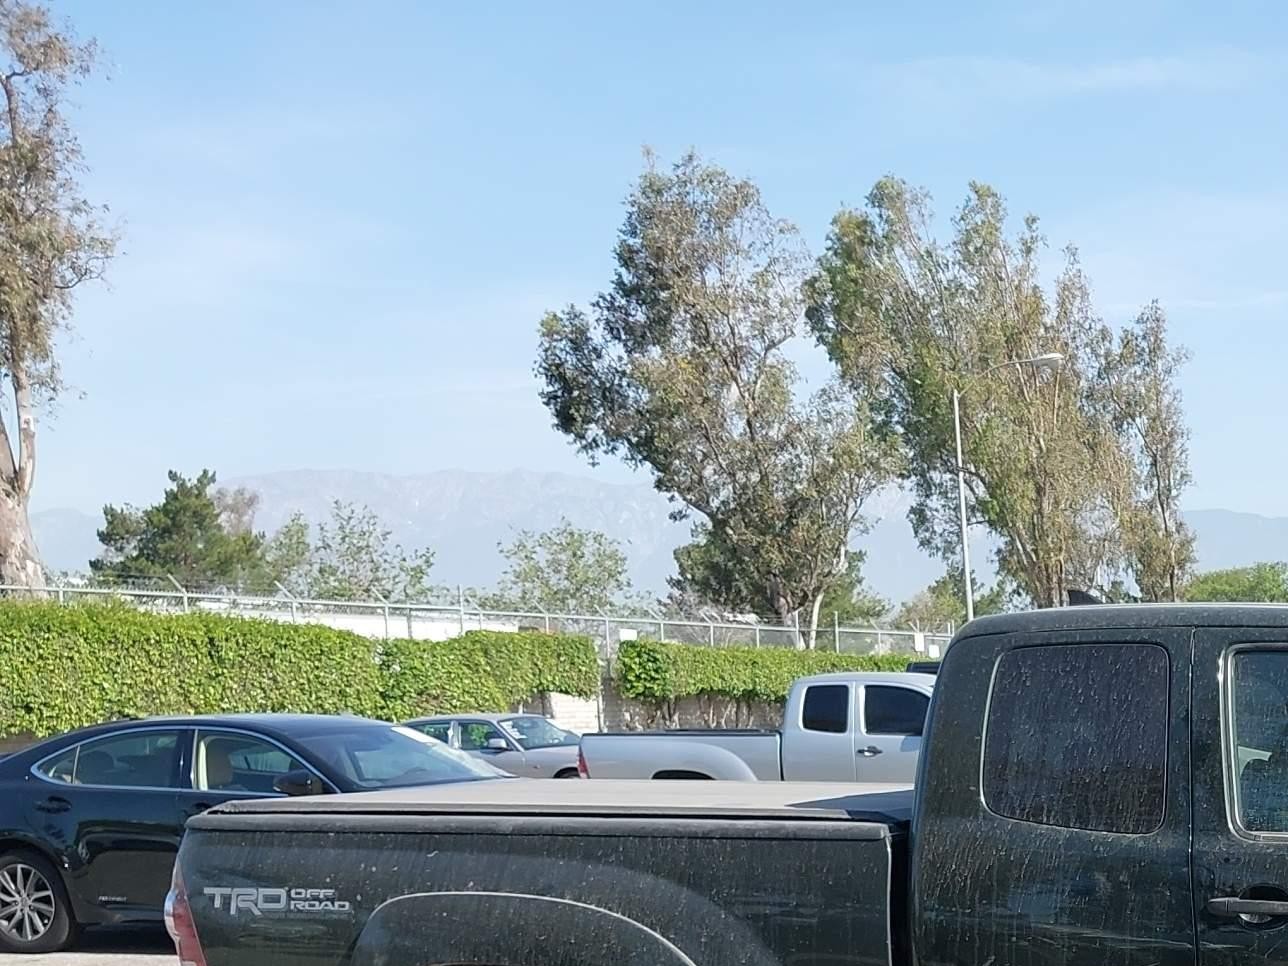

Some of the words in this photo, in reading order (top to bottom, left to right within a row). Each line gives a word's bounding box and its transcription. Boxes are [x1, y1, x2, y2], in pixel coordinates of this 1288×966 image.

[290, 888, 336, 898] OFF
[203, 887, 286, 916] TRD
[290, 901, 350, 911] ROAD
